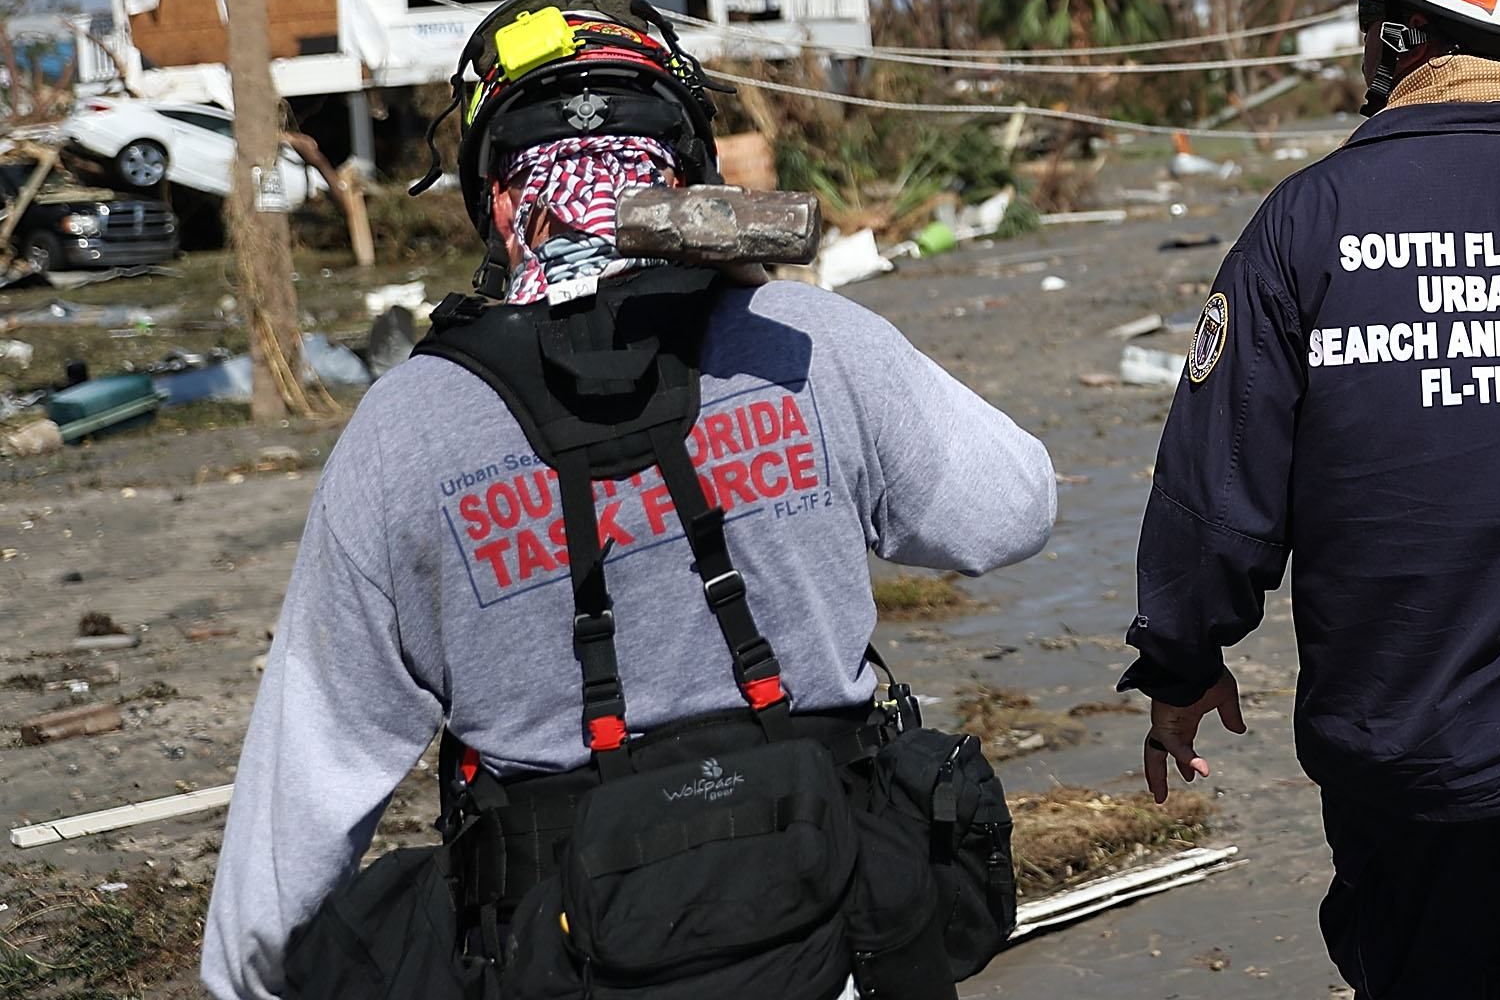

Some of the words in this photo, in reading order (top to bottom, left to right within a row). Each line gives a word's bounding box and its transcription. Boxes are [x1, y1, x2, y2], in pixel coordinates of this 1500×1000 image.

[1339, 232, 1456, 272] SOUTH
[1308, 321, 1438, 367] SEARCH
[441, 464, 499, 497] Urban
[503, 453, 542, 471] Sea
[774, 493, 819, 519] FL-TF
[824, 490, 833, 507] 2
[662, 771, 744, 801] Wolfpack
